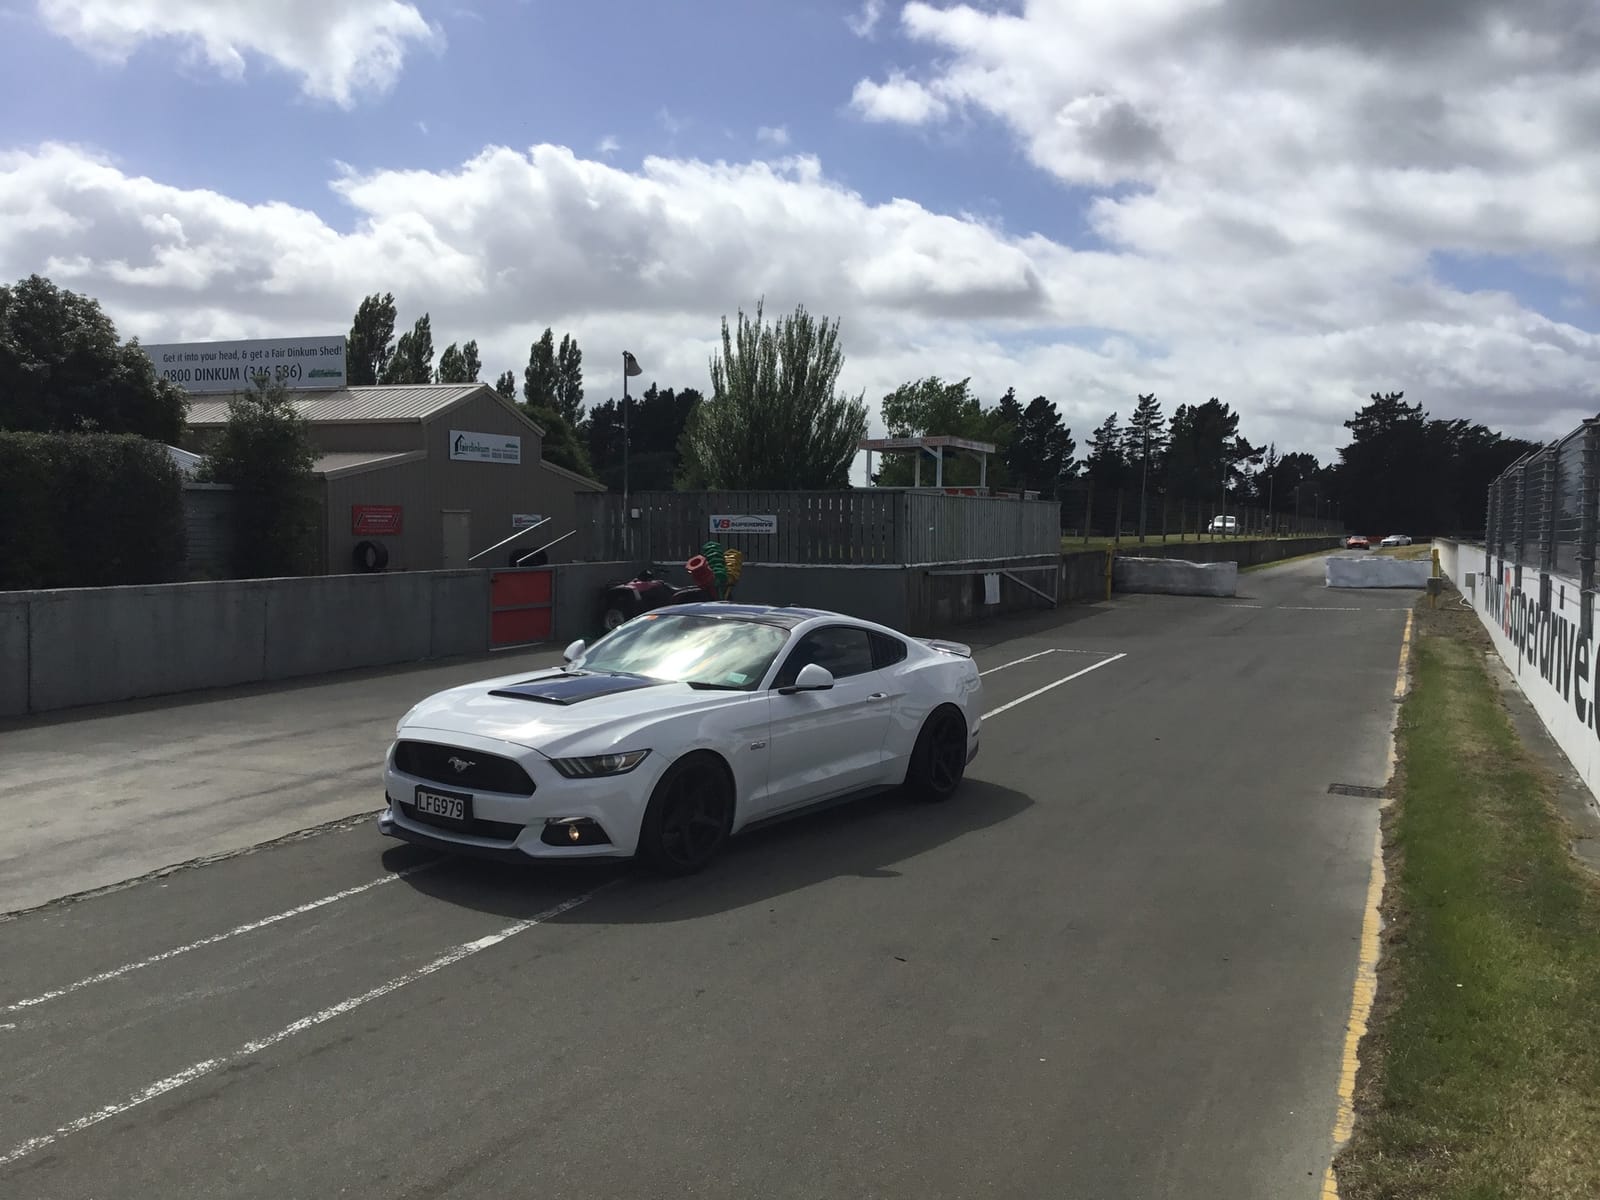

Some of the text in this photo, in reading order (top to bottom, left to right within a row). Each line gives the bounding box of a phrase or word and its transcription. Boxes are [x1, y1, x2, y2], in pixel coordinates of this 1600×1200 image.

[163, 354, 175, 363] Get
[177, 353, 183, 361] it
[184, 352, 199, 361] into
[200, 352, 217, 363] your
[218, 349, 240, 361] head,
[241, 350, 247, 359] &
[249, 349, 263, 361] get
[271, 348, 286, 358] Fair
[287, 346, 318, 357] Dinkum
[319, 345, 342, 356] Shed!
[163, 368, 191, 382] 0800
[194, 367, 240, 381] DINKUM
[419, 794, 463, 818] LFG979
